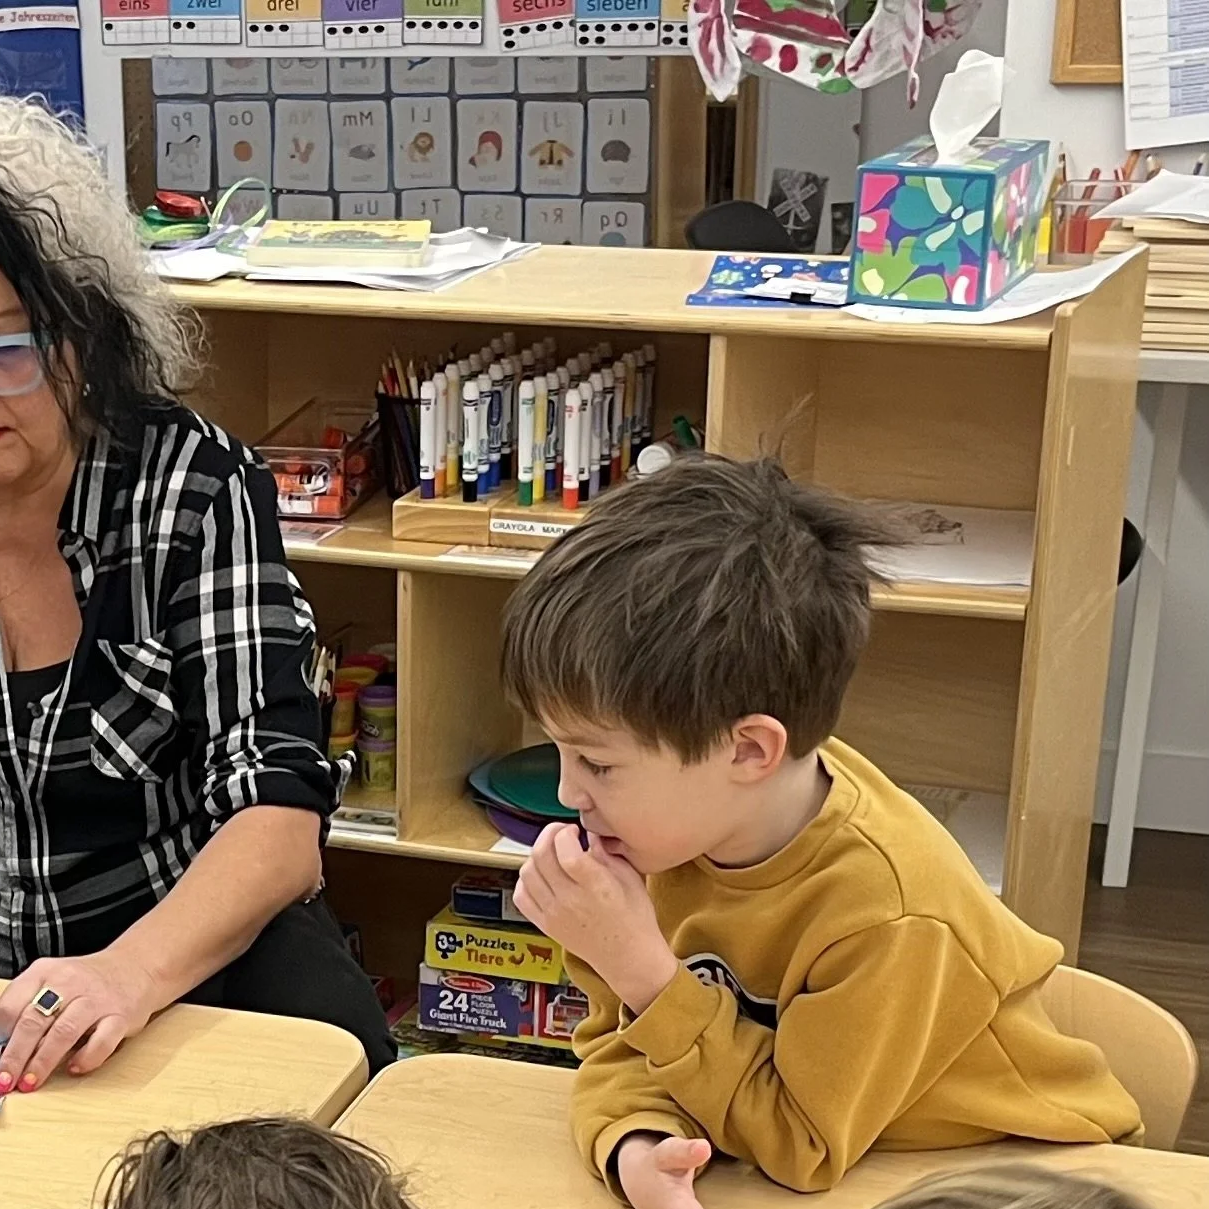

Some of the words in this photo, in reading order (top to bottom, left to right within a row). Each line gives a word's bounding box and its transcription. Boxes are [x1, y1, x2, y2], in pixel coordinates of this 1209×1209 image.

[118, 0, 150, 11] eins
[187, 0, 222, 9] zwei
[267, 0, 300, 11] drei
[346, 0, 378, 12] vier
[493, 522, 535, 532] CRAYOLA
[542, 526, 567, 535] MARK
[466, 934, 515, 951] Puzzles
[466, 949, 504, 966] Tiere
[439, 989, 469, 1012] 24
[429, 1008, 458, 1021] Giant
[459, 1012, 479, 1025] Fire
[478, 1015, 507, 1029] Truck
